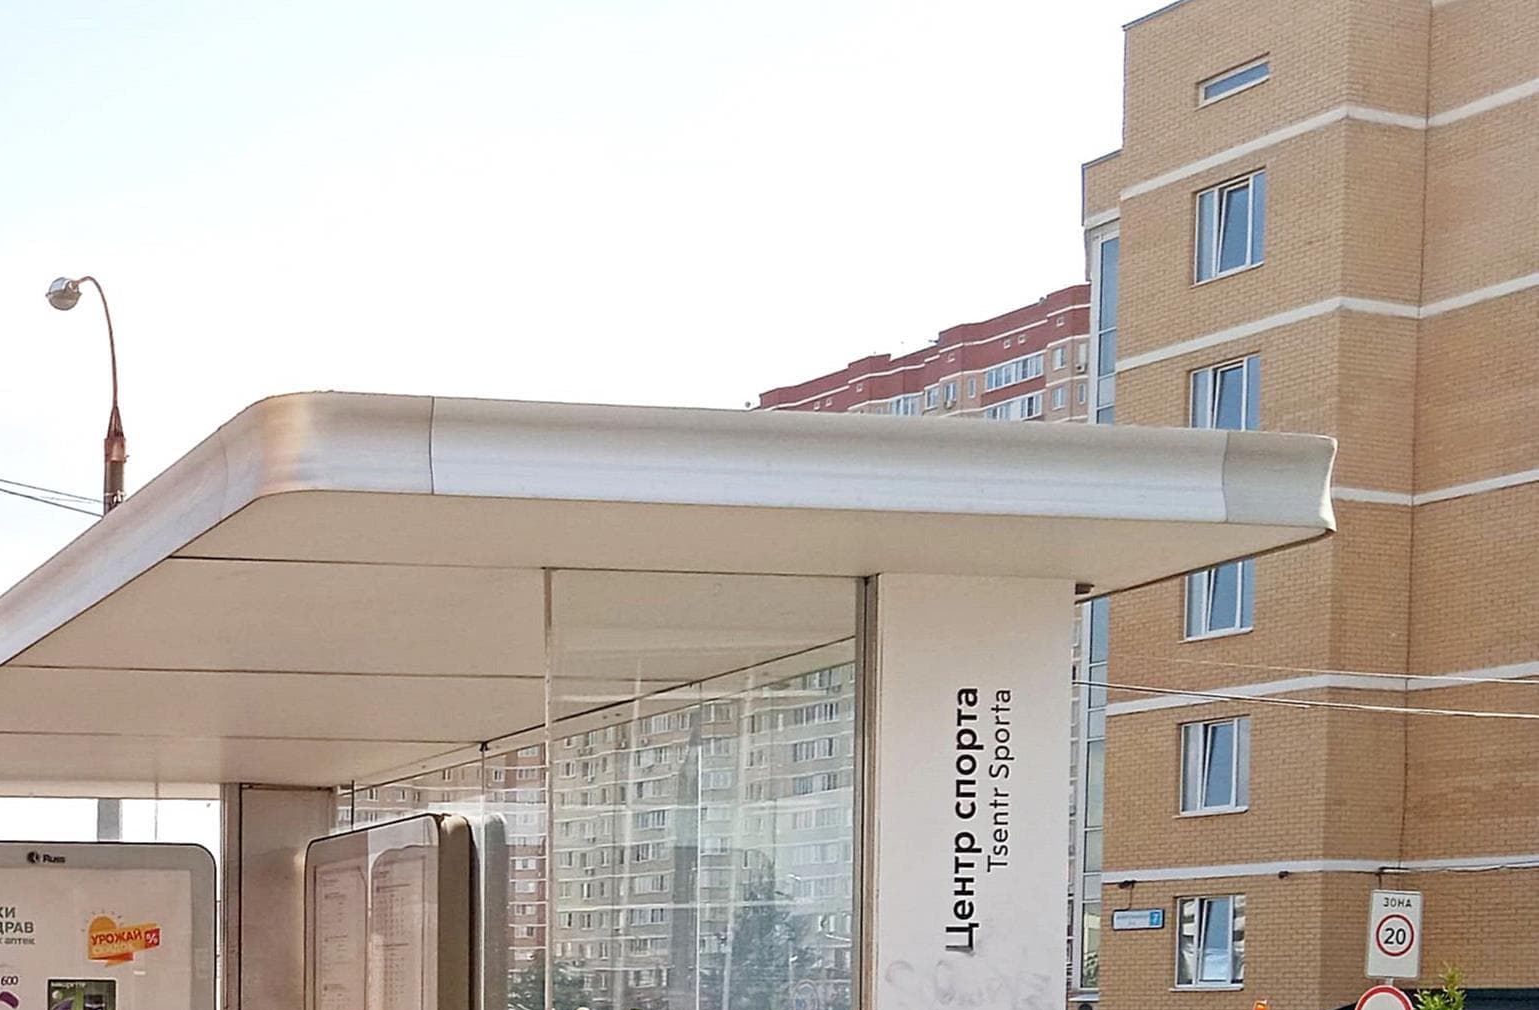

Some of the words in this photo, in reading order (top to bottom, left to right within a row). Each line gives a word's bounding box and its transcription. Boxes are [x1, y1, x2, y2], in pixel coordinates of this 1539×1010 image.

[989, 688, 1015, 780] Sporta
[954, 687, 985, 820] спорта
[987, 786, 1010, 873] Tsentr
[945, 830, 983, 953] Центр
[1383, 897, 1412, 908] ЗОНА
[4, 936, 36, 945] аптек
[91, 928, 142, 946] УРОЖАЙ
[1383, 927, 1406, 945] 20
[0, 975, 19, 986] 600
